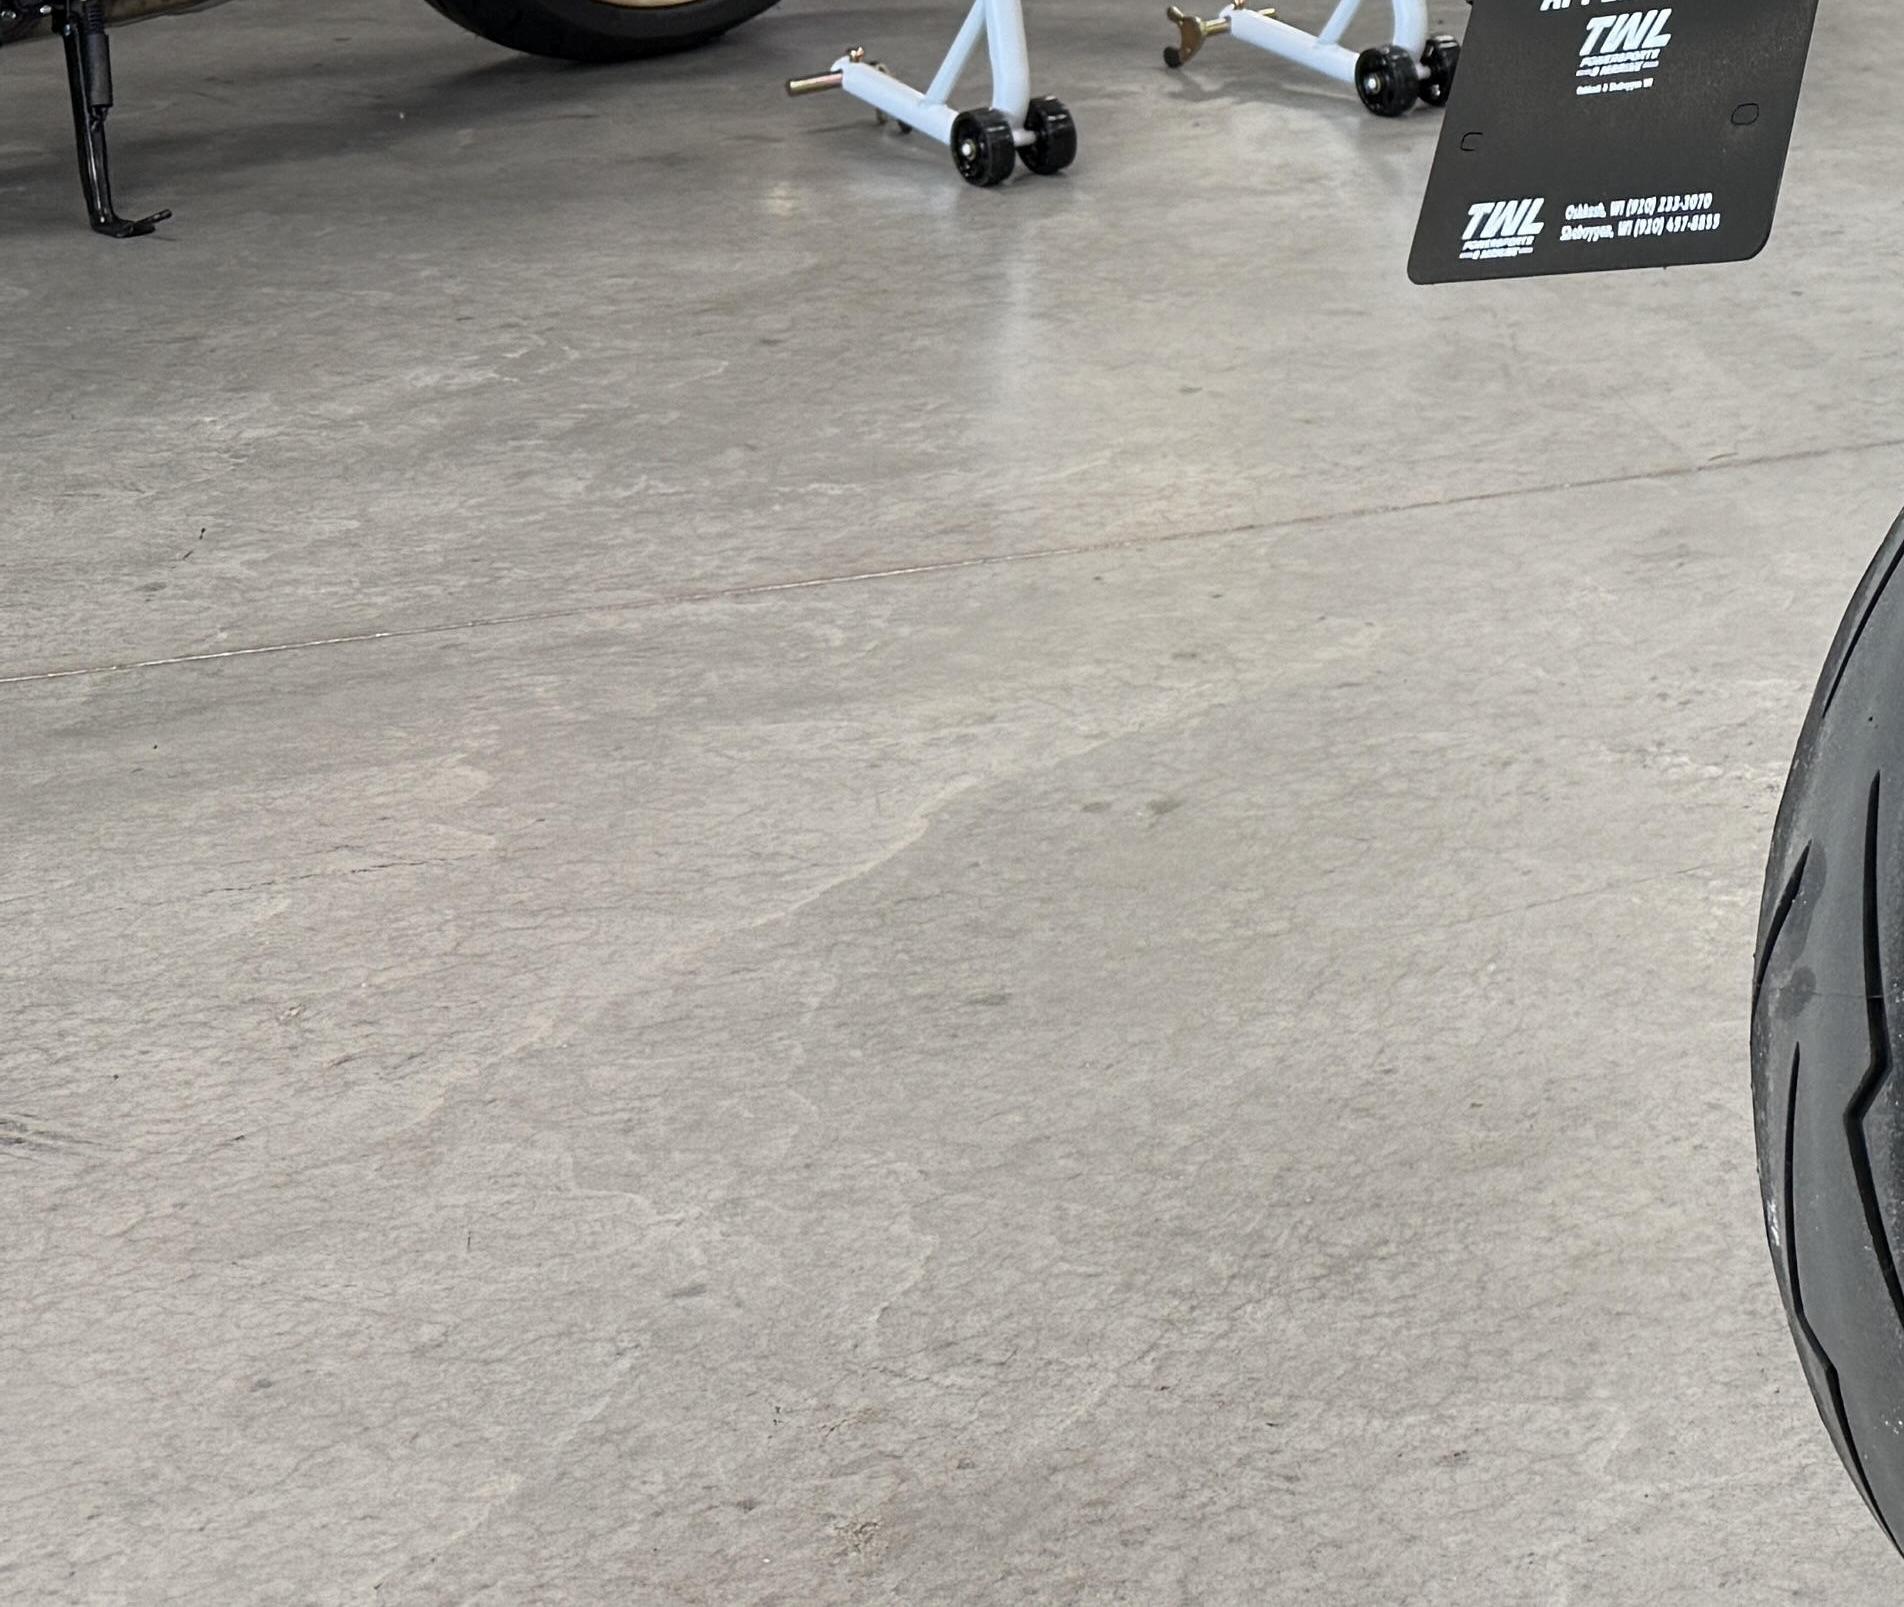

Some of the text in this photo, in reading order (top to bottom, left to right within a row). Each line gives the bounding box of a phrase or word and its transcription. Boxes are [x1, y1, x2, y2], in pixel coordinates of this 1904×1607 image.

[1579, 8, 1673, 57] TWL
[1461, 197, 1545, 241] TWL
[1609, 199, 1626, 217] WI
[1617, 218, 1634, 238] WI
